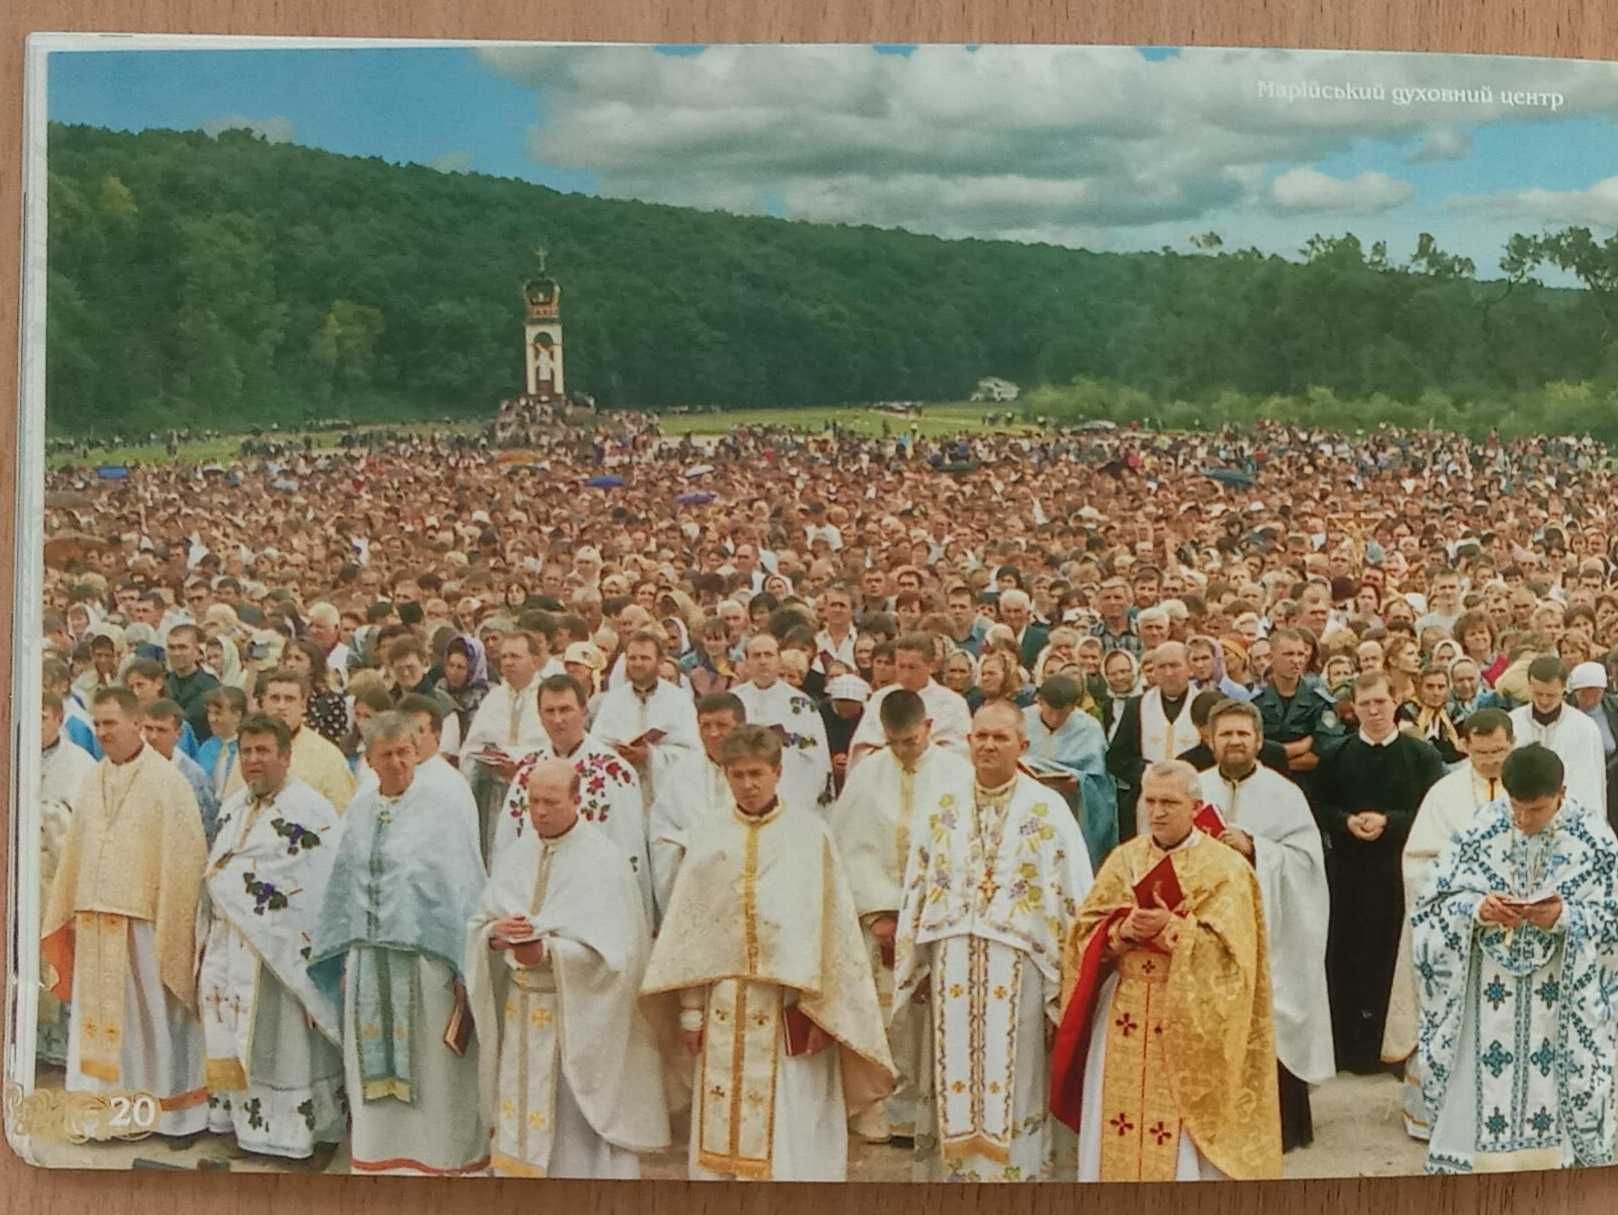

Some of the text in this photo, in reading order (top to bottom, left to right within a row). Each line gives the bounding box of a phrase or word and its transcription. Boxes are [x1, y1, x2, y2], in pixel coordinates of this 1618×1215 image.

[1392, 84, 1493, 105] духовний
[1501, 89, 1564, 110] центр
[109, 1096, 155, 1127] 20
